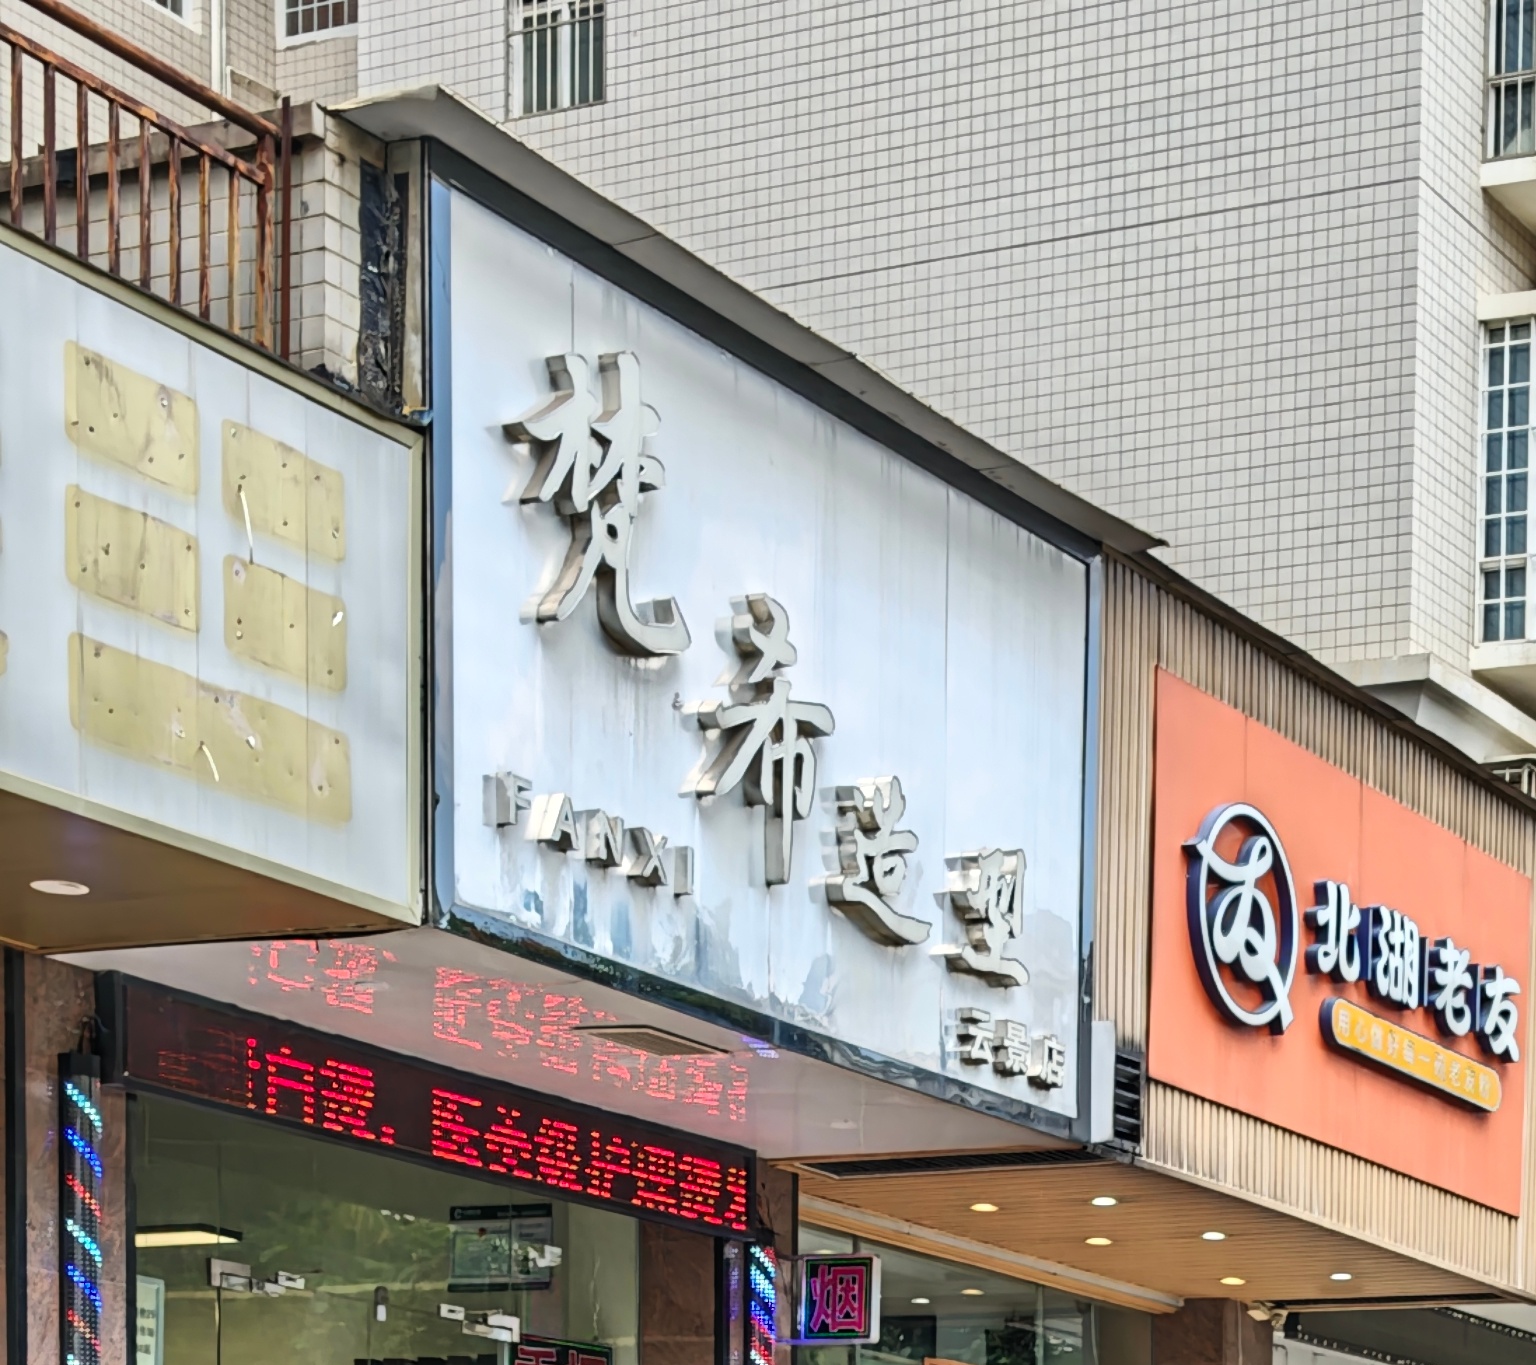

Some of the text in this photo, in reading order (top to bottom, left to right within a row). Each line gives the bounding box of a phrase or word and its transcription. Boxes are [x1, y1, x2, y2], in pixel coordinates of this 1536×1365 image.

[502, 350, 1030, 988] 梵希造型
[483, 769, 696, 898] FANXI
[944, 1006, 1067, 1091] 云景店
[810, 1263, 867, 1334] 烟
